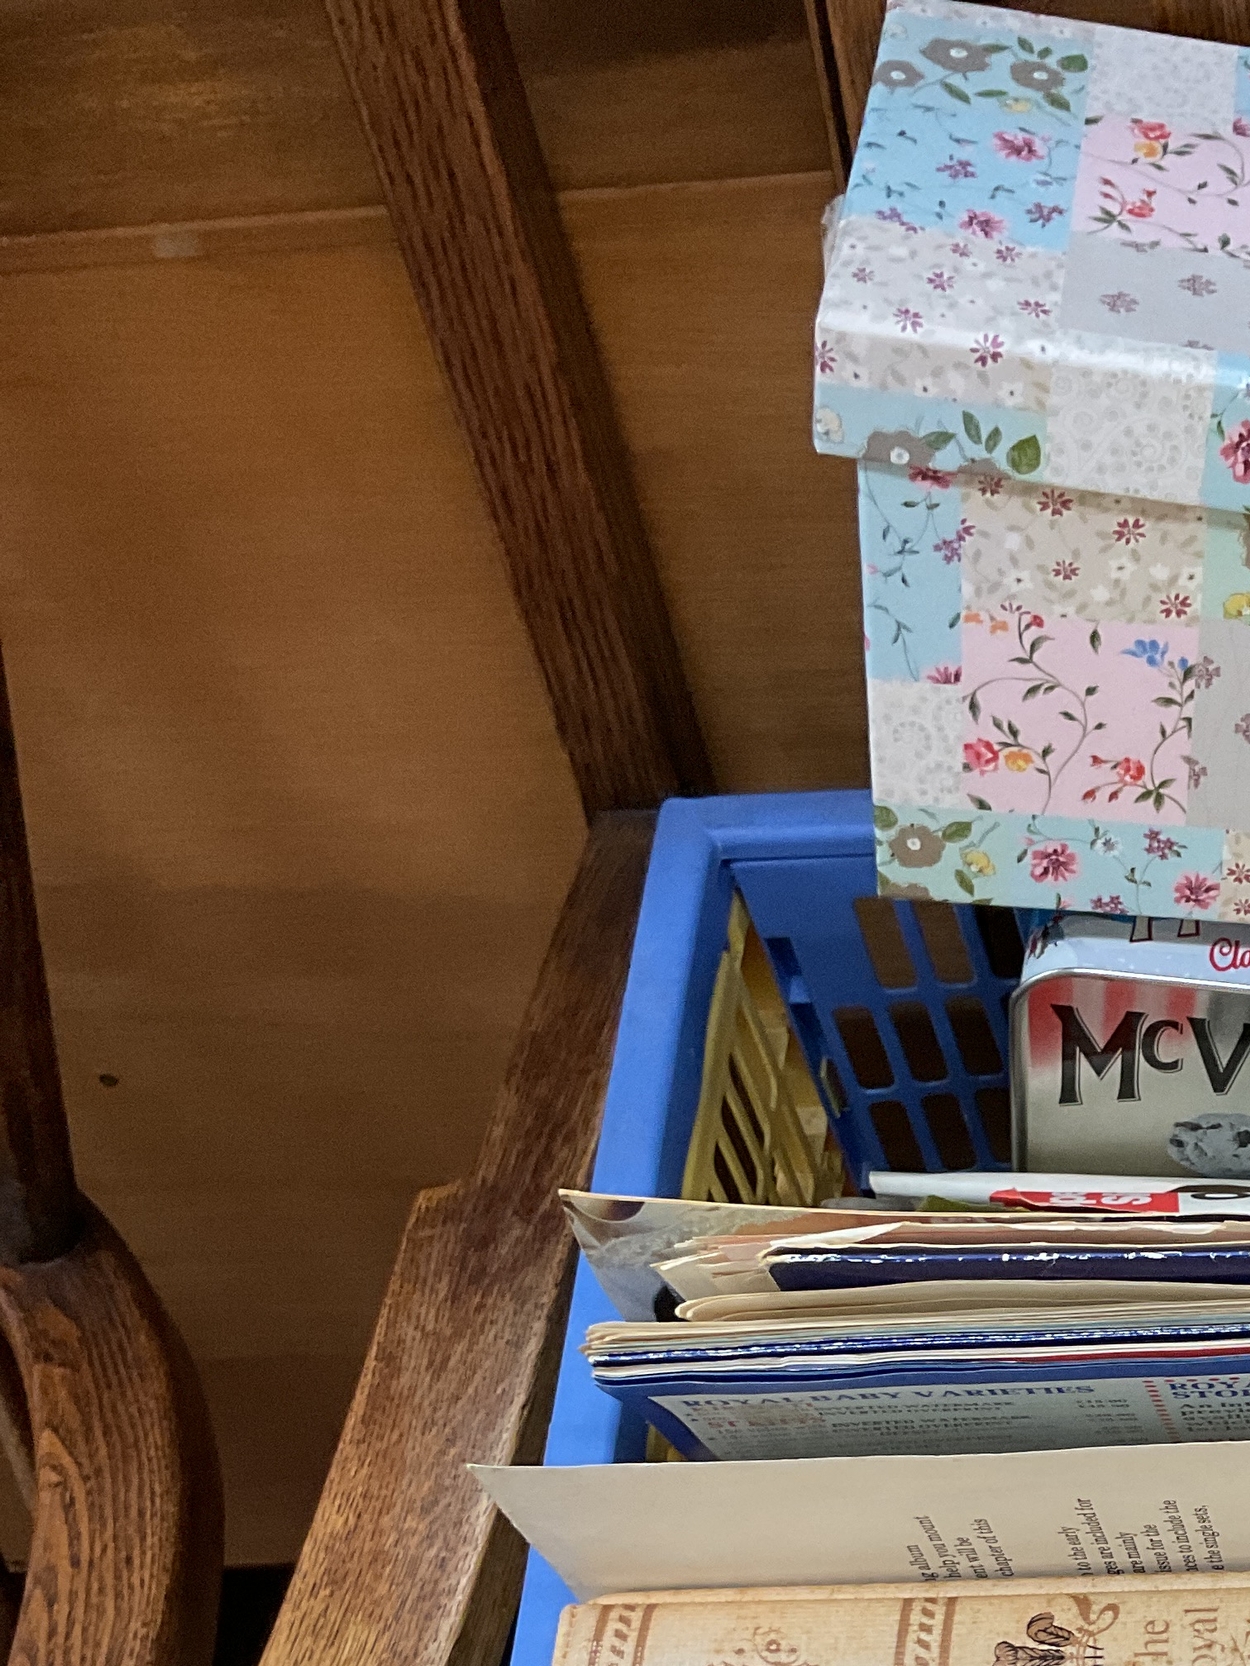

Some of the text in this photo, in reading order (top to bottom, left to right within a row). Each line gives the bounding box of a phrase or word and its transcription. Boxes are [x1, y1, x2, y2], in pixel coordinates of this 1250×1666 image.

[809, 1392, 900, 1401] BABY
[914, 1386, 1095, 1398] VARIETIES
[1074, 1498, 1094, 1512] for
[1158, 1499, 1180, 1515] the
[1193, 1504, 1212, 1525] sets,
[1057, 1525, 1082, 1546] early
[1076, 1512, 1109, 1546] included
[1139, 1523, 1161, 1538] the
[1162, 1514, 1191, 1545] include
[1194, 1524, 1221, 1550] single
[912, 1515, 962, 1579] help you mount
[953, 1536, 973, 1549] be
[969, 1518, 1015, 1577] chapter of this
[1145, 1538, 1166, 1551] for
[1176, 1545, 1193, 1554] to
[906, 1544, 931, 1571] album
[956, 1547, 981, 1563] will
[1067, 1545, 1088, 1561] the
[1098, 1546, 1114, 1560] are
[1114, 1531, 1147, 1574] are mainly
[1203, 1550, 1223, 1564] the
[1076, 1560, 1092, 1571] to
